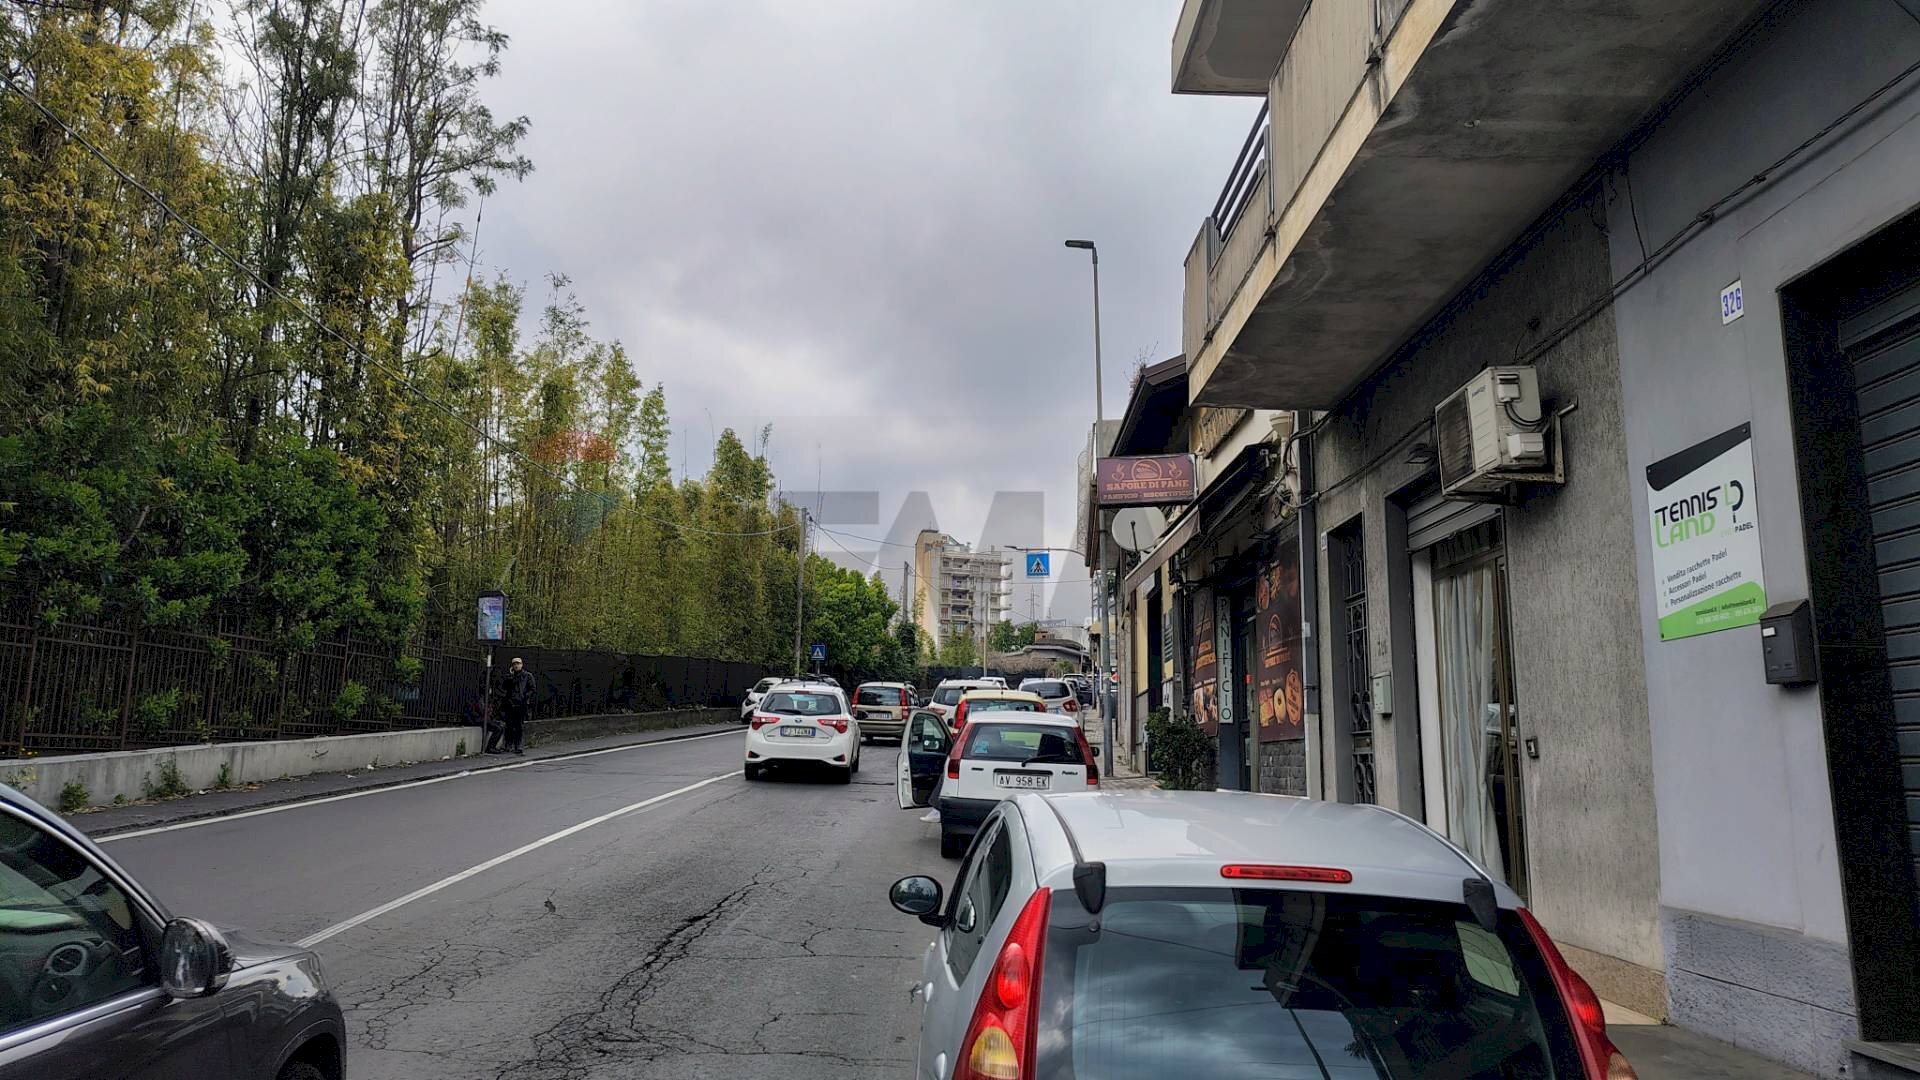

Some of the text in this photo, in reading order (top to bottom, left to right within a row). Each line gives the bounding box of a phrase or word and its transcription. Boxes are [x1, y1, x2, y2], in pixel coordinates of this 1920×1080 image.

[1722, 288, 1742, 317] 326
[1106, 479, 1189, 491] SAPORE DI PANE
[1734, 522, 1754, 533] PADEL
[1666, 547, 1728, 583] Vendita racchette Padel
[1668, 571, 1707, 595] Accessori Padel
[1670, 582, 1715, 607] Personalizzazione
[1715, 571, 1742, 587] racchette
[1220, 598, 1232, 720] PANIFICIO
[999, 775, 1011, 785] AV
[1015, 776, 1033, 787] 958
